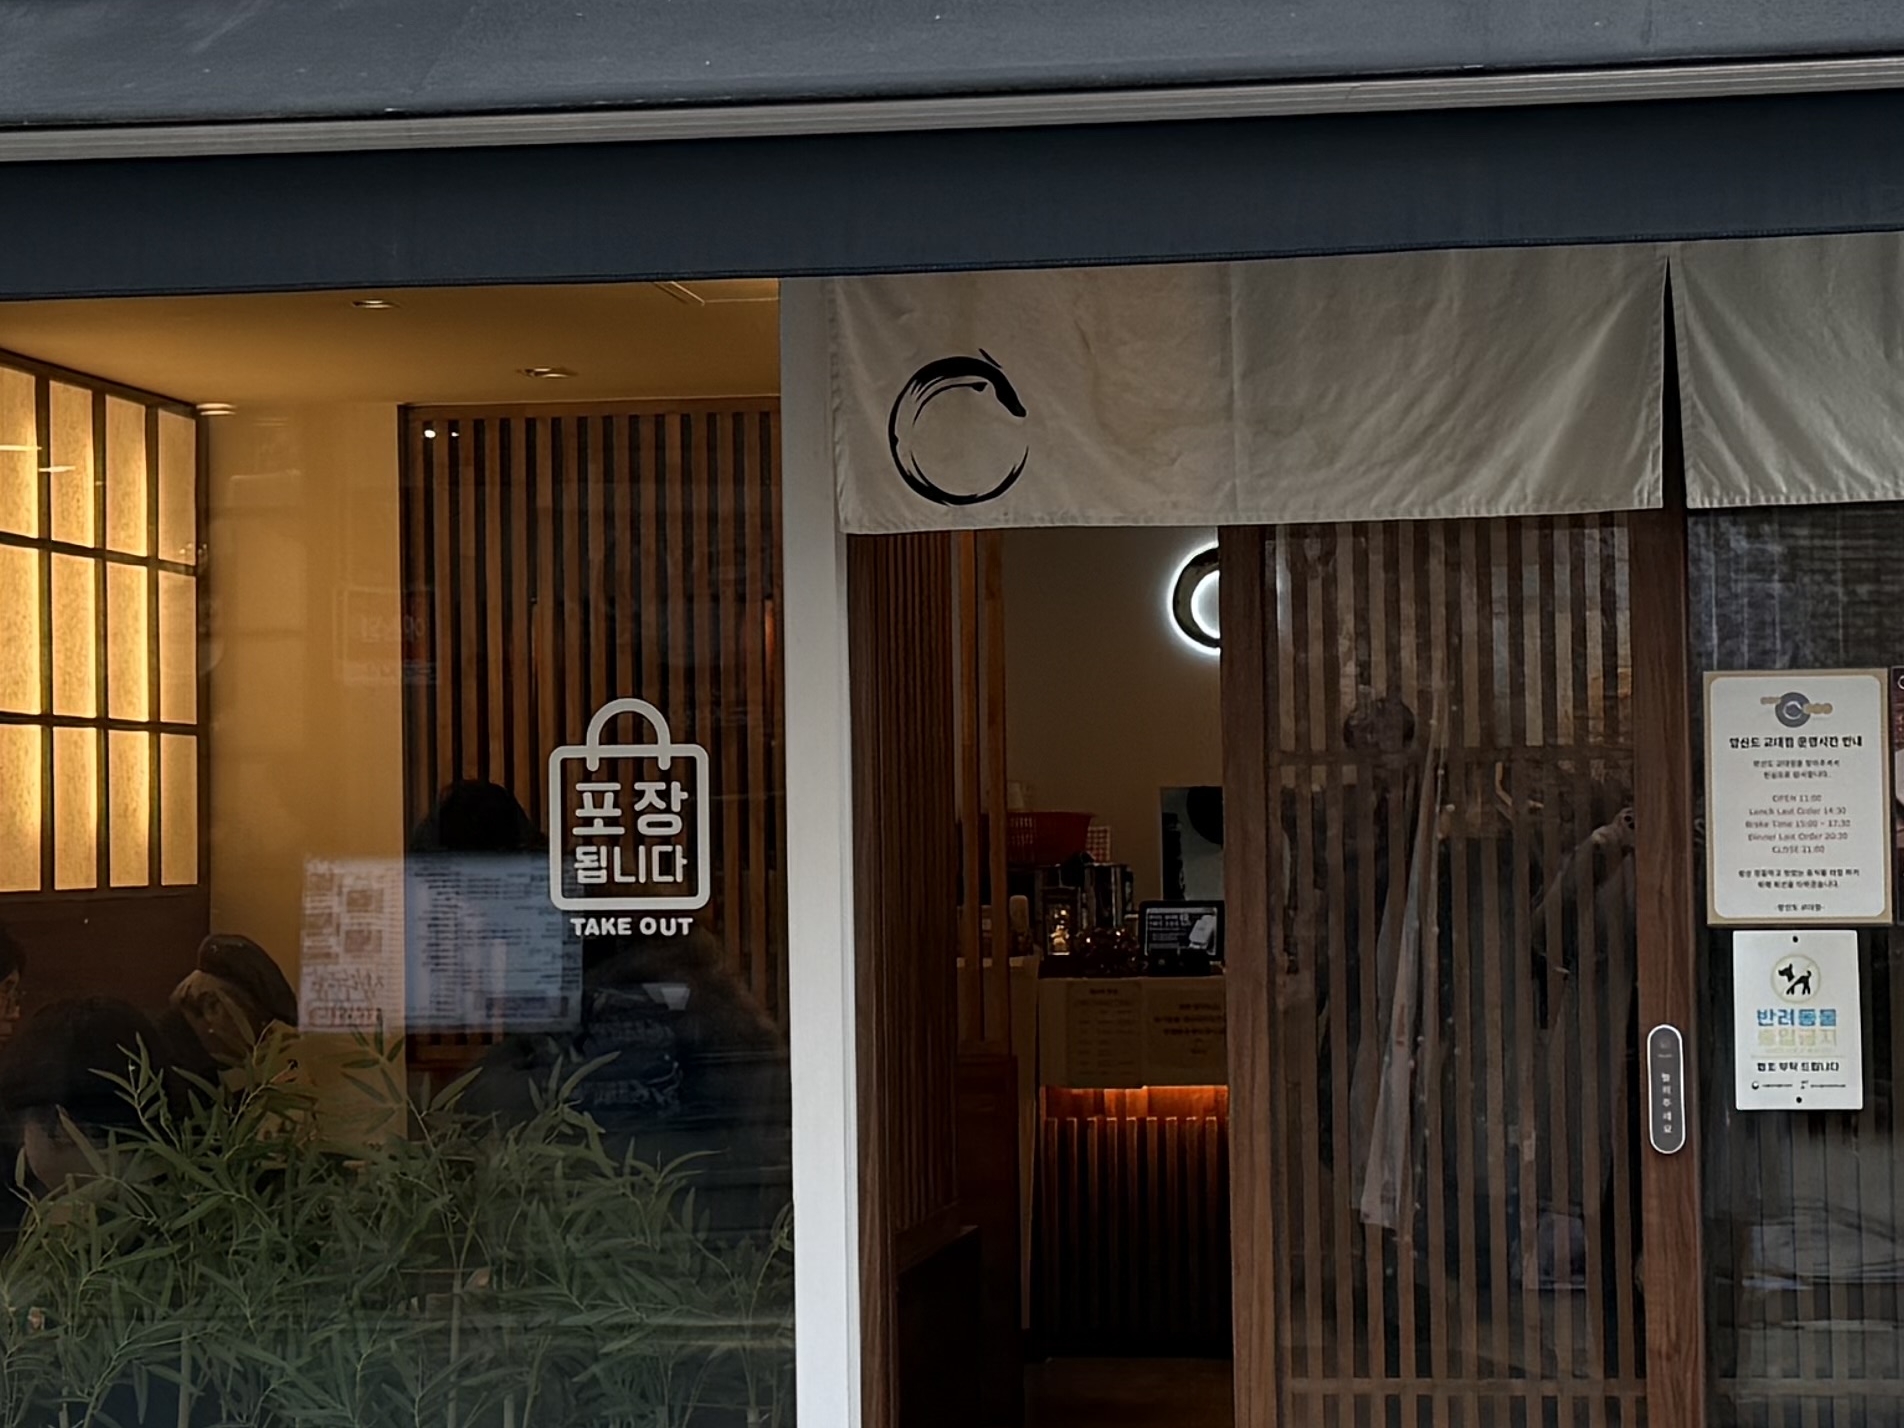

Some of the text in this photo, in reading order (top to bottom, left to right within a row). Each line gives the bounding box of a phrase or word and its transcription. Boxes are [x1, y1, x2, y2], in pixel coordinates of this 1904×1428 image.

[572, 781, 689, 836] 포장
[574, 845, 688, 884] 됩니다
[570, 917, 693, 936] TAKE OUT
